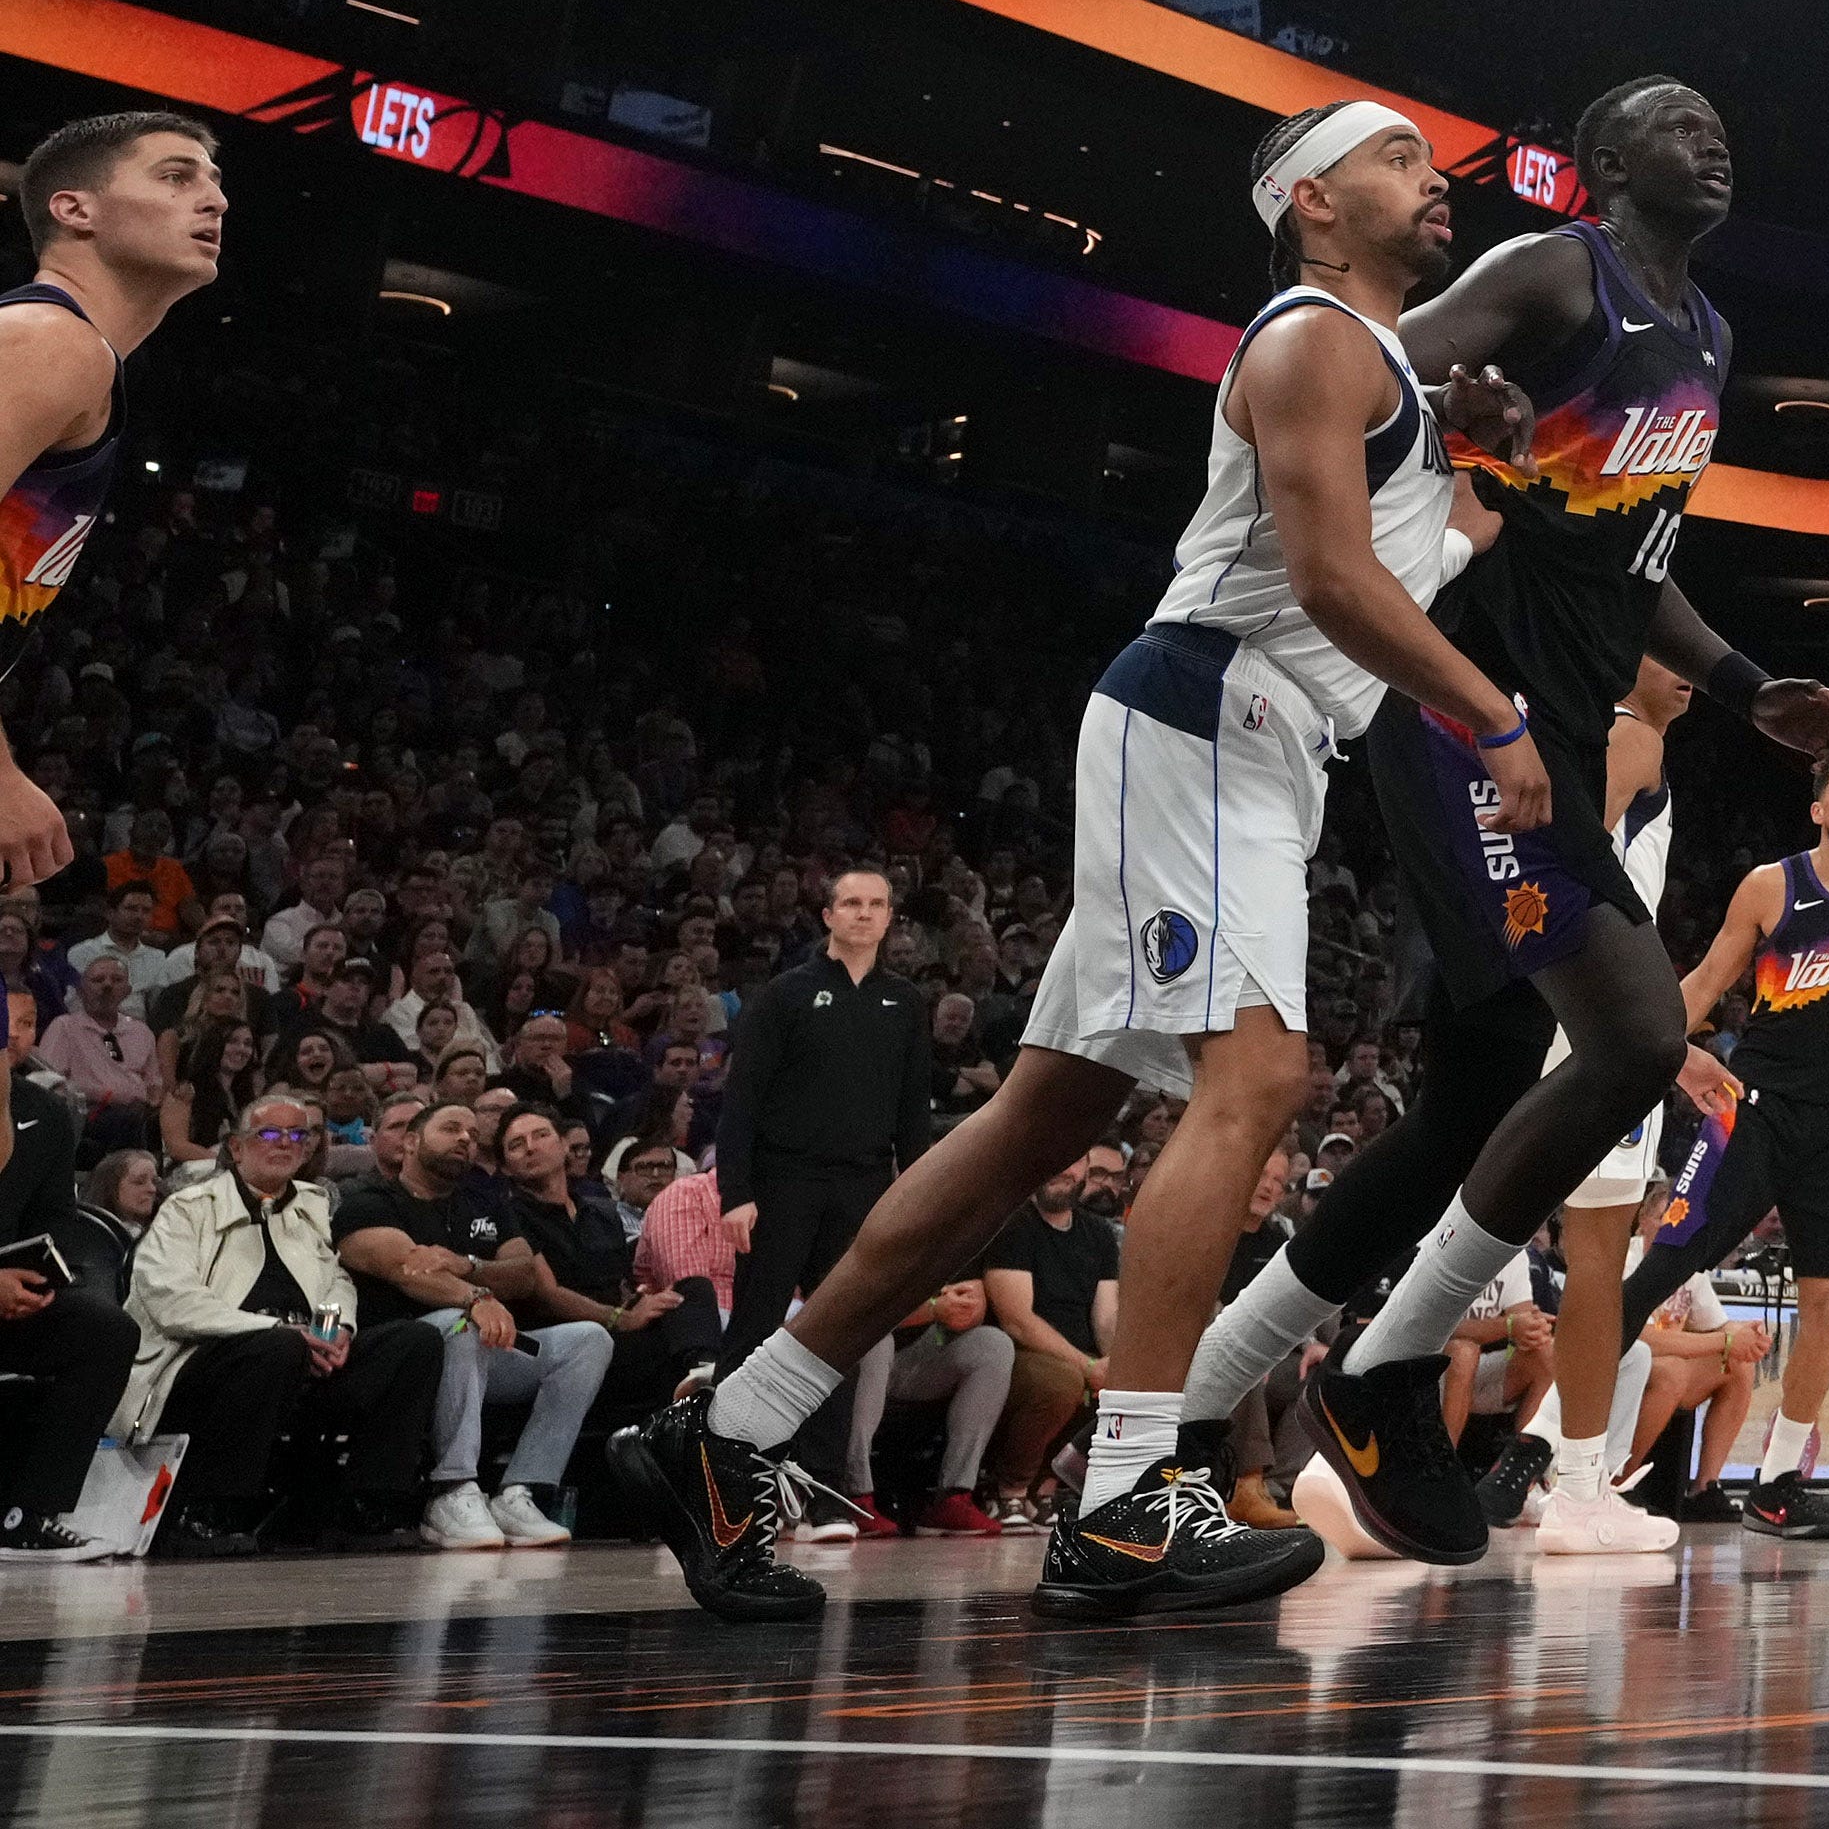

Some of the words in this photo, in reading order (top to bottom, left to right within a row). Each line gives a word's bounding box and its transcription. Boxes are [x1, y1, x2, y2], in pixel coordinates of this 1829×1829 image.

[361, 83, 435, 158] LETS
[1514, 146, 1557, 205] LETS
[1655, 417, 1676, 428] THE
[1627, 508, 1681, 583] 10
[1676, 1139, 1709, 1194] SUNS
